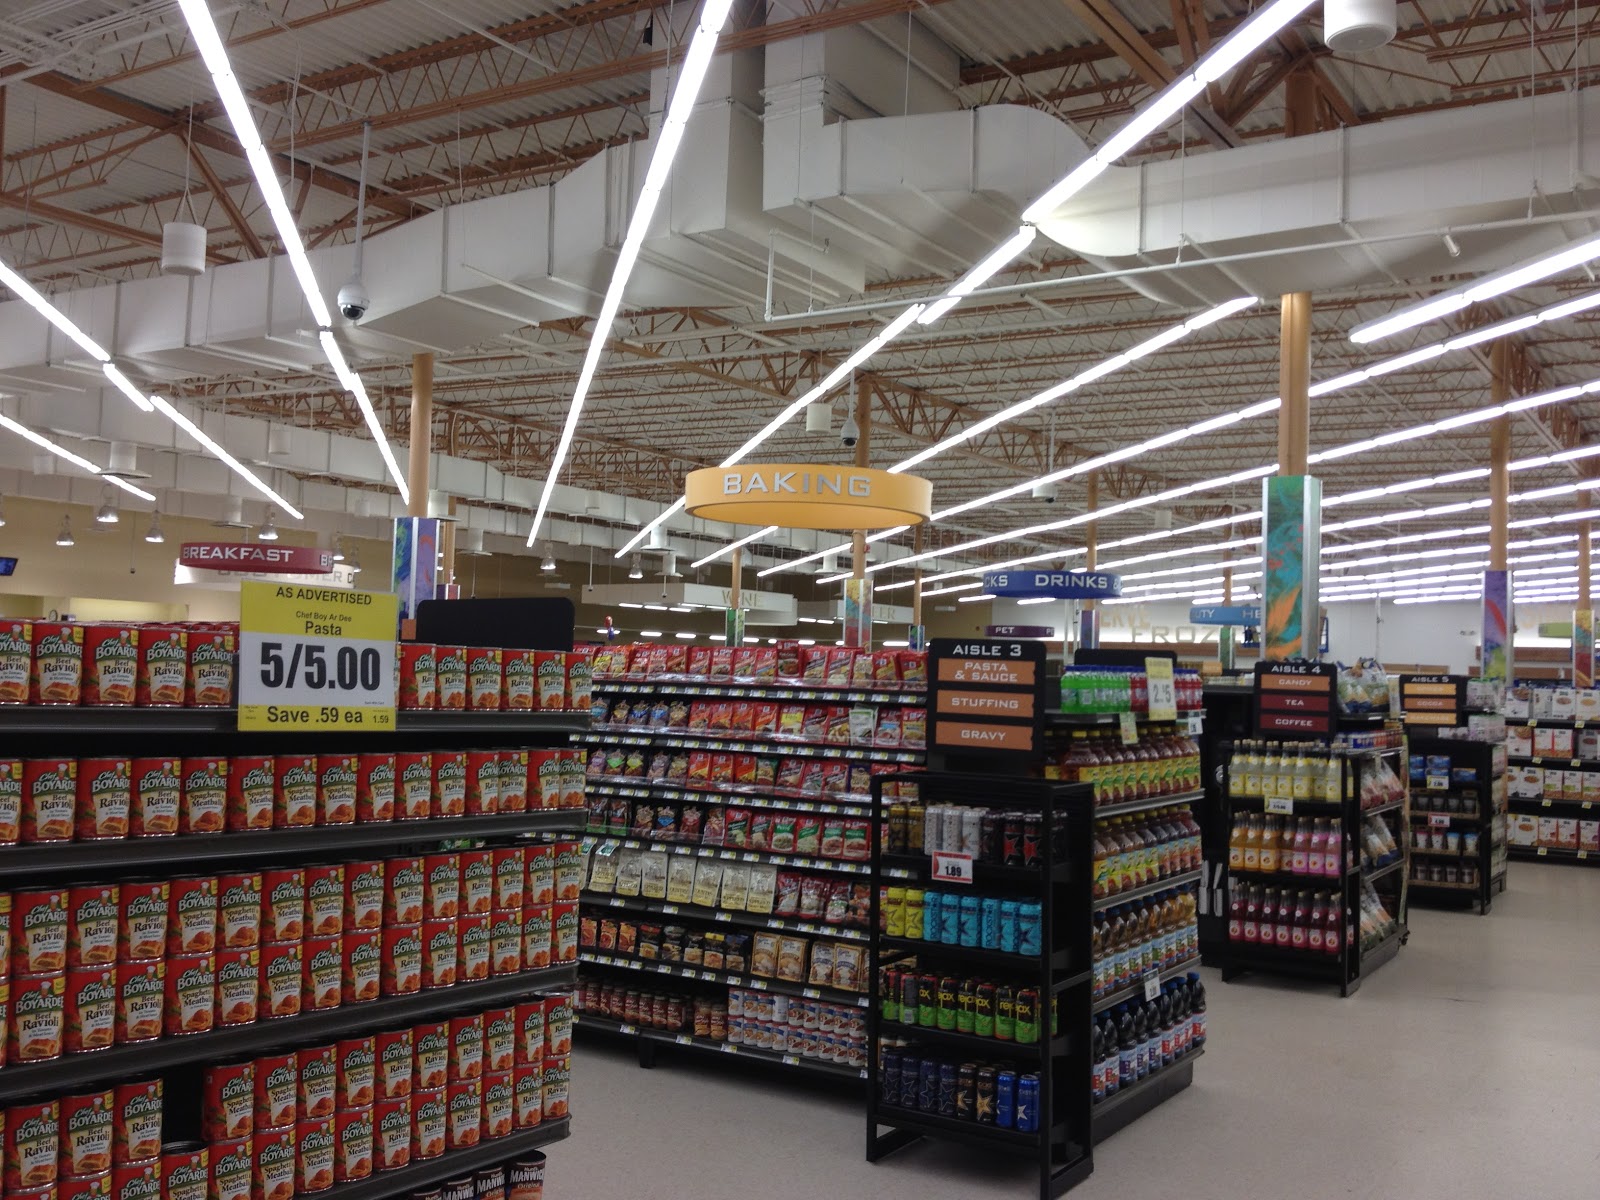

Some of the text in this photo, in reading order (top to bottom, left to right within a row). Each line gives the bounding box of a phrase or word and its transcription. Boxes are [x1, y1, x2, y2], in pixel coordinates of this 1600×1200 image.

[723, 471, 871, 497] BAKING
[183, 547, 293, 562] BREAKFAST
[985, 575, 1008, 587] CKS
[1035, 575, 1107, 588] DRINKS
[276, 587, 372, 605] AS ADVERTISED
[722, 590, 765, 607] WNE
[296, 610, 312, 618] Chef
[314, 612, 327, 621] Boy
[339, 614, 352, 622] Dee
[305, 621, 342, 636] Pasta
[37, 643, 82, 655] BOYARDE
[96, 646, 137, 659] BOYARDE
[147, 648, 186, 660] BOYARDE
[952, 644, 1021, 656] AISLE 3
[192, 650, 233, 663] BOYARDE
[261, 641, 380, 691] 5/5.00
[964, 662, 1008, 672] PASTA
[1271, 665, 1321, 674] AISLE 4
[954, 671, 1018, 682] & SAUCE
[1278, 678, 1312, 686] CANDY
[952, 698, 1019, 709] STUFFING
[267, 706, 363, 723] Save .59 ea
[372, 715, 389, 723] 1.59
[1275, 718, 1313, 726] COFFEE
[961, 730, 1006, 740] GRAVY
[33, 779, 76, 794] BOYARDE
[139, 777, 180, 791] BOYARDE
[77, 906, 118, 920] BOYARDE
[128, 902, 168, 916] BOYARDE
[25, 911, 67, 927] BOYARDE
[123, 980, 164, 996] BOYARDE
[125, 1100, 162, 1117] BOYARDE
[69, 1112, 113, 1130] BOYARDE
[16, 1122, 59, 1141] BOYARDE
[121, 1183, 161, 1200] BOYARDE
